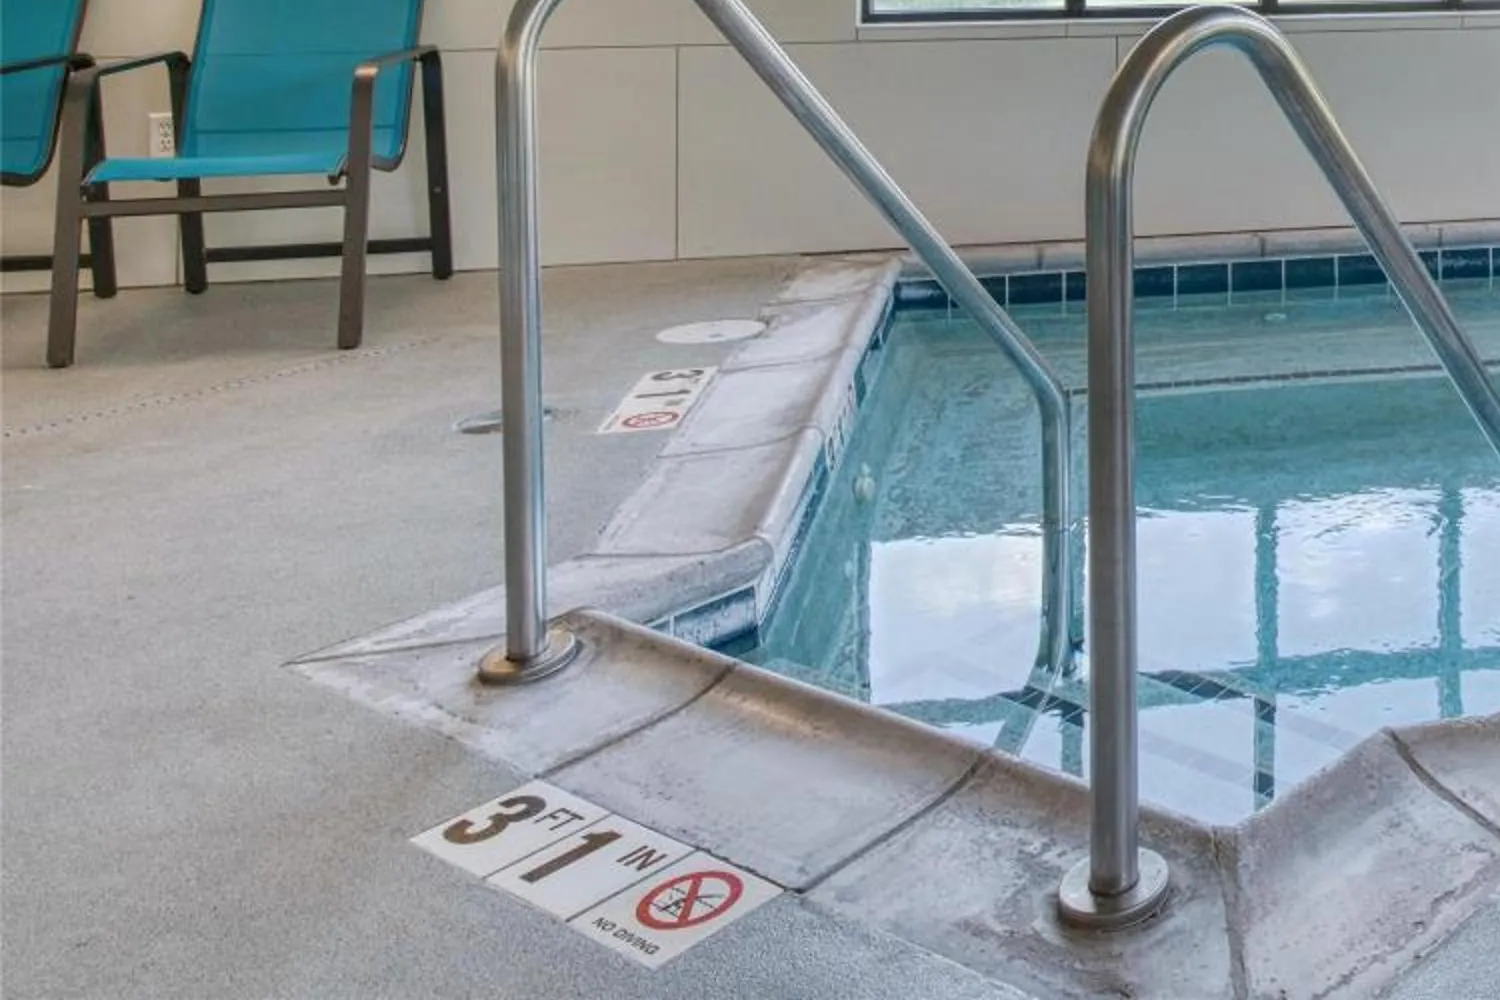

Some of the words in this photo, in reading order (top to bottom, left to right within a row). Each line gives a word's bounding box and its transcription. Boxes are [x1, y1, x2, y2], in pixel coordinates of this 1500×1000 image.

[442, 795, 547, 845] 3
[533, 807, 585, 831] FT
[519, 829, 624, 883] 1
[615, 844, 669, 872] IN
[592, 917, 617, 932] NO
[612, 928, 660, 955] DIVING
